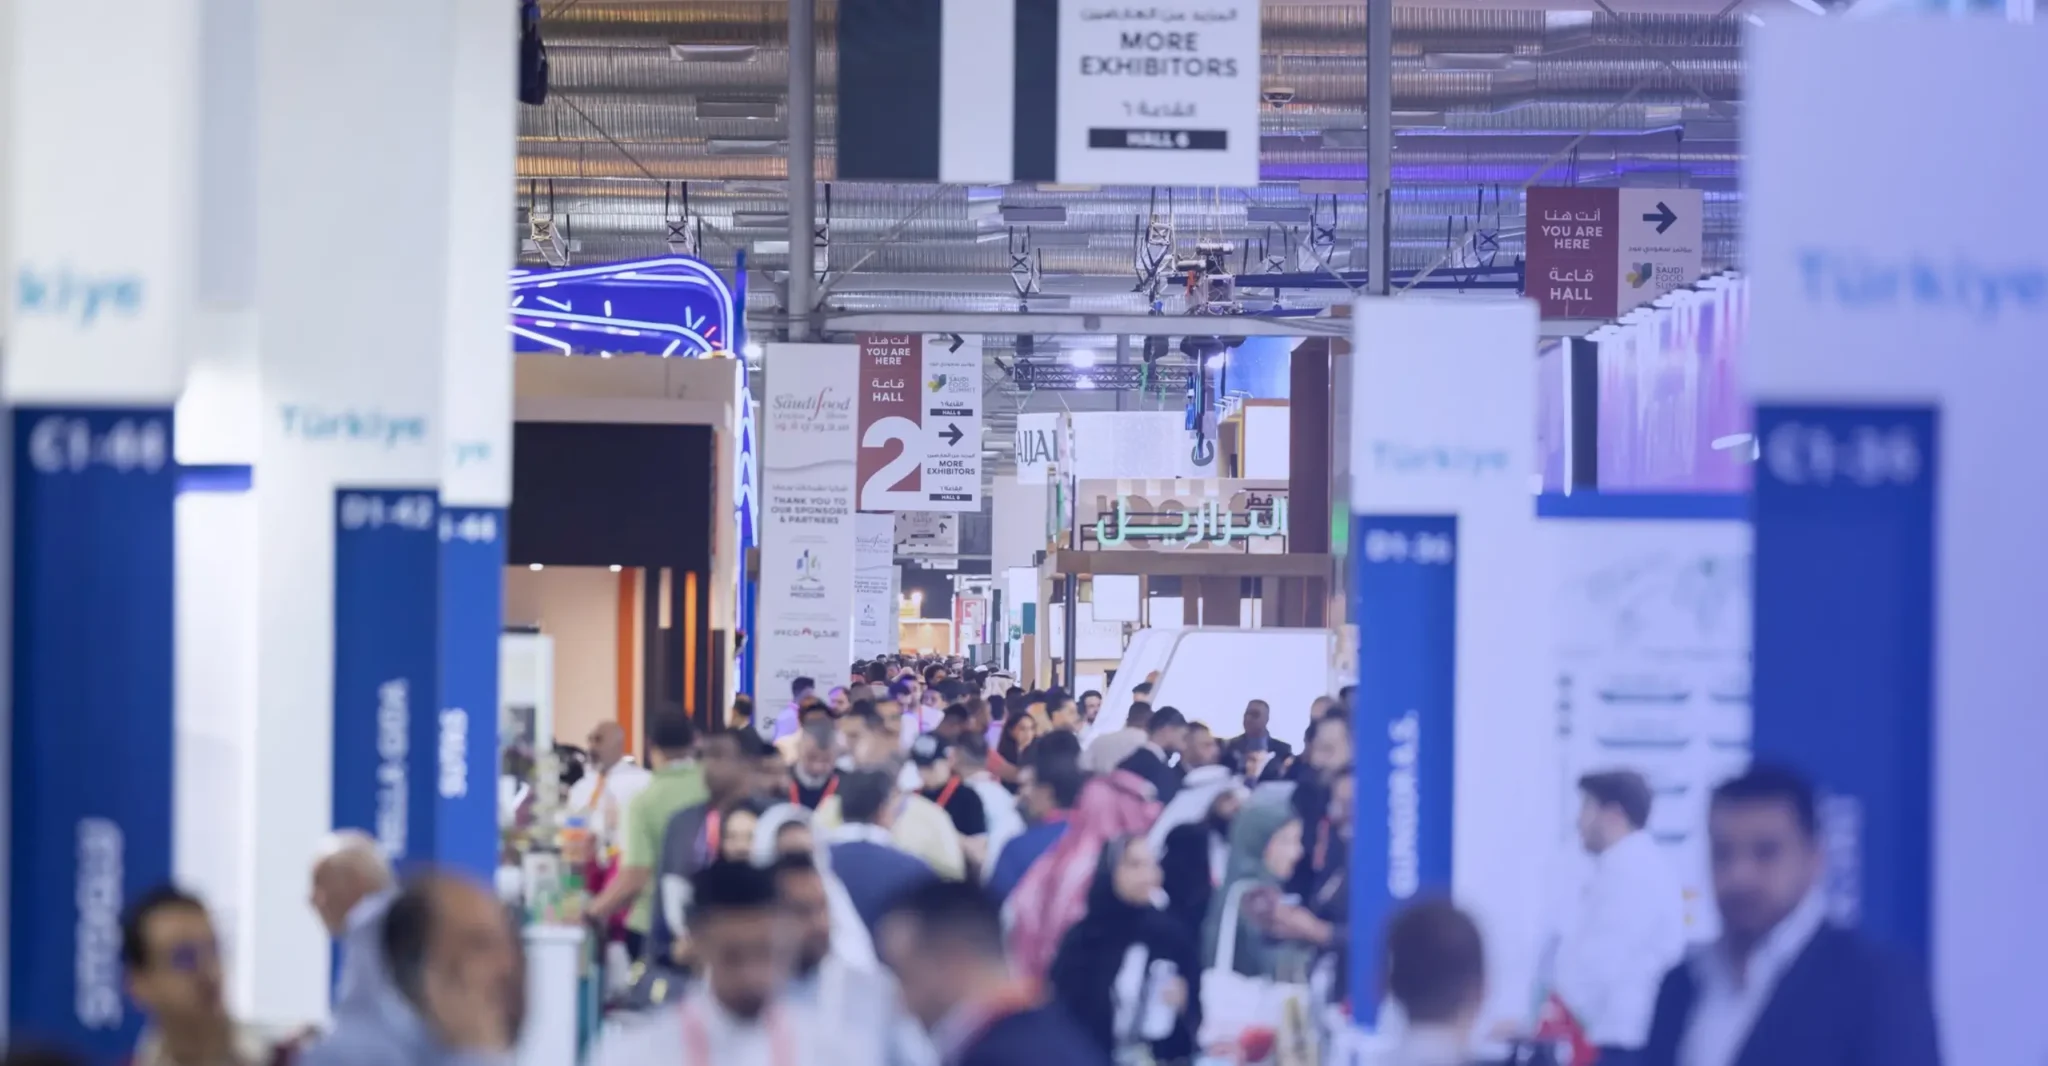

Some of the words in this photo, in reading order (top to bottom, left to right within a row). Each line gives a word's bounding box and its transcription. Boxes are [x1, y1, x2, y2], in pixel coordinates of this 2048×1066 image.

[1120, 31, 1199, 51] MORE
[1080, 56, 1239, 77] EXHIBITORS
[1126, 130, 1174, 147] HALL
[1544, 209, 1572, 221] هنا
[1575, 208, 1601, 221] أنت
[1541, 225, 1571, 237] YOU
[1575, 226, 1603, 237] ARE
[1554, 238, 1590, 250] HERE
[1548, 266, 1594, 282] قاعة
[1655, 266, 1684, 274] SAUDI
[1655, 274, 1684, 282] FOOD
[1549, 287, 1592, 300] HALL
[866, 347, 888, 356] YOU
[890, 347, 911, 356] ARE
[875, 356, 902, 365] HERE
[871, 377, 905, 389] قاعة
[872, 391, 904, 402] HALL
[861, 416, 922, 511] 2
[773, 497, 807, 505] THANK
[809, 497, 831, 505] YOU
[833, 498, 847, 506] TO
[770, 506, 792, 514] OUR
[794, 506, 848, 515] SPONSORS
[788, 516, 839, 524] PARTNERS
